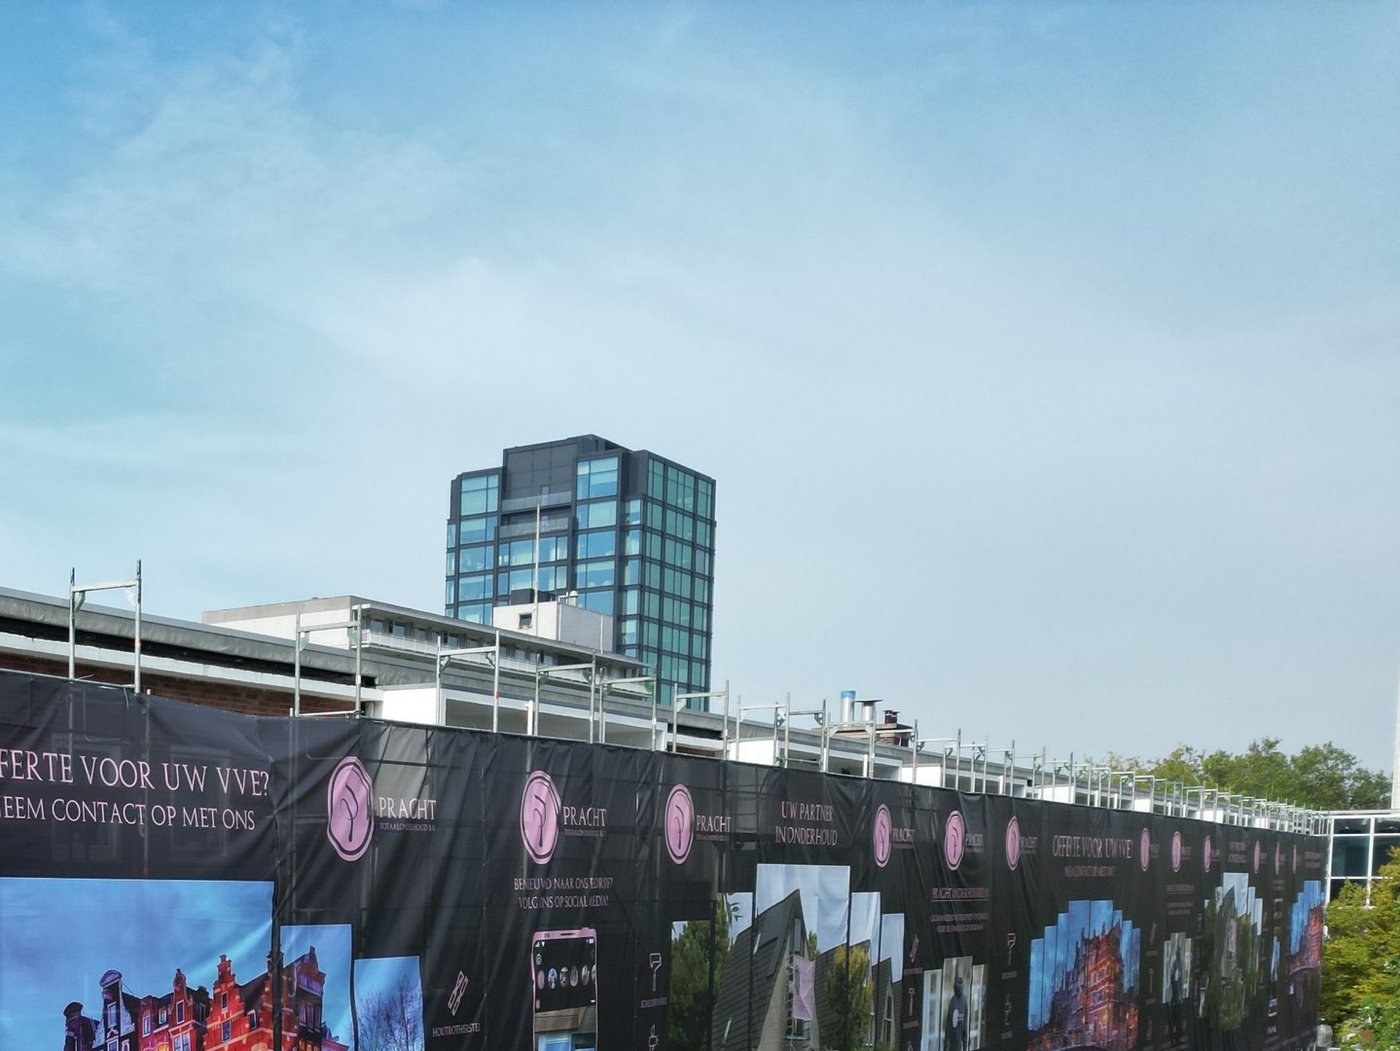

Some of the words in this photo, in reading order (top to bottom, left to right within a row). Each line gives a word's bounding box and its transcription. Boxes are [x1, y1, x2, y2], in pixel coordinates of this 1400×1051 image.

[79, 755, 155, 789] VOOR
[162, 763, 207, 793] UW
[215, 767, 270, 797] VVE?
[51, 798, 145, 825] CONTACT
[151, 804, 176, 826] OP
[182, 806, 217, 829] MET
[222, 808, 255, 831] ONS
[378, 796, 437, 820] PRACHT
[563, 806, 606, 827] PRACHT
[781, 801, 798, 819] UW
[799, 802, 834, 822] PARTNER
[696, 814, 731, 833] PRACHT
[788, 826, 838, 846] ONDERHOUD
